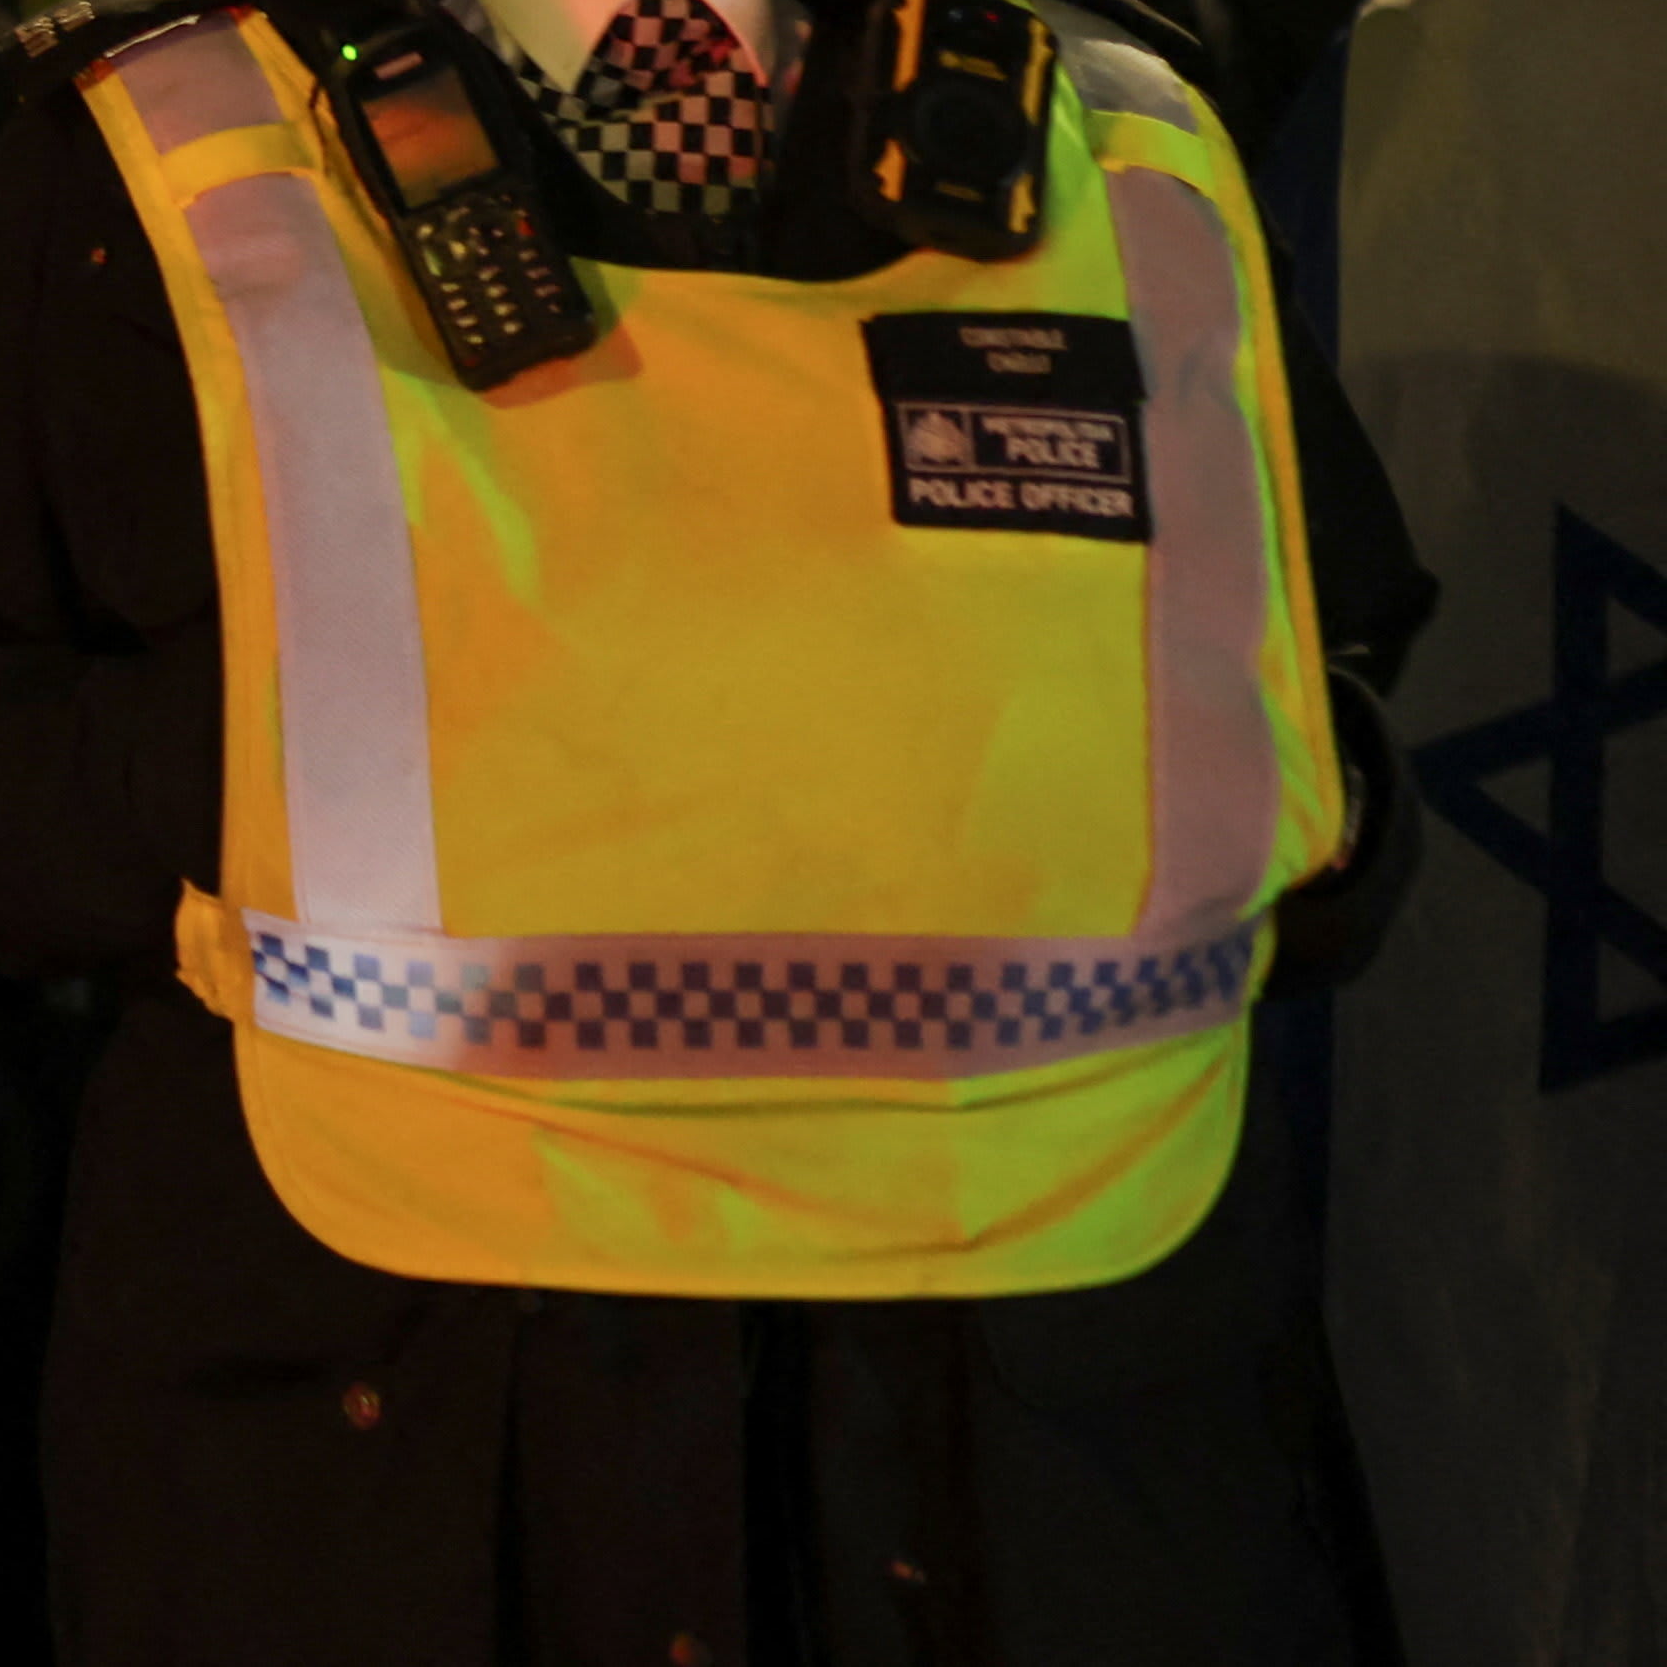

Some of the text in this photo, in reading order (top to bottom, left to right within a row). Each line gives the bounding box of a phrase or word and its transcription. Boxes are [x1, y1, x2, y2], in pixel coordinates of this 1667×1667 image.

[1005, 436, 1102, 469] POLICE
[907, 477, 1135, 518] POLICE OFFICER
